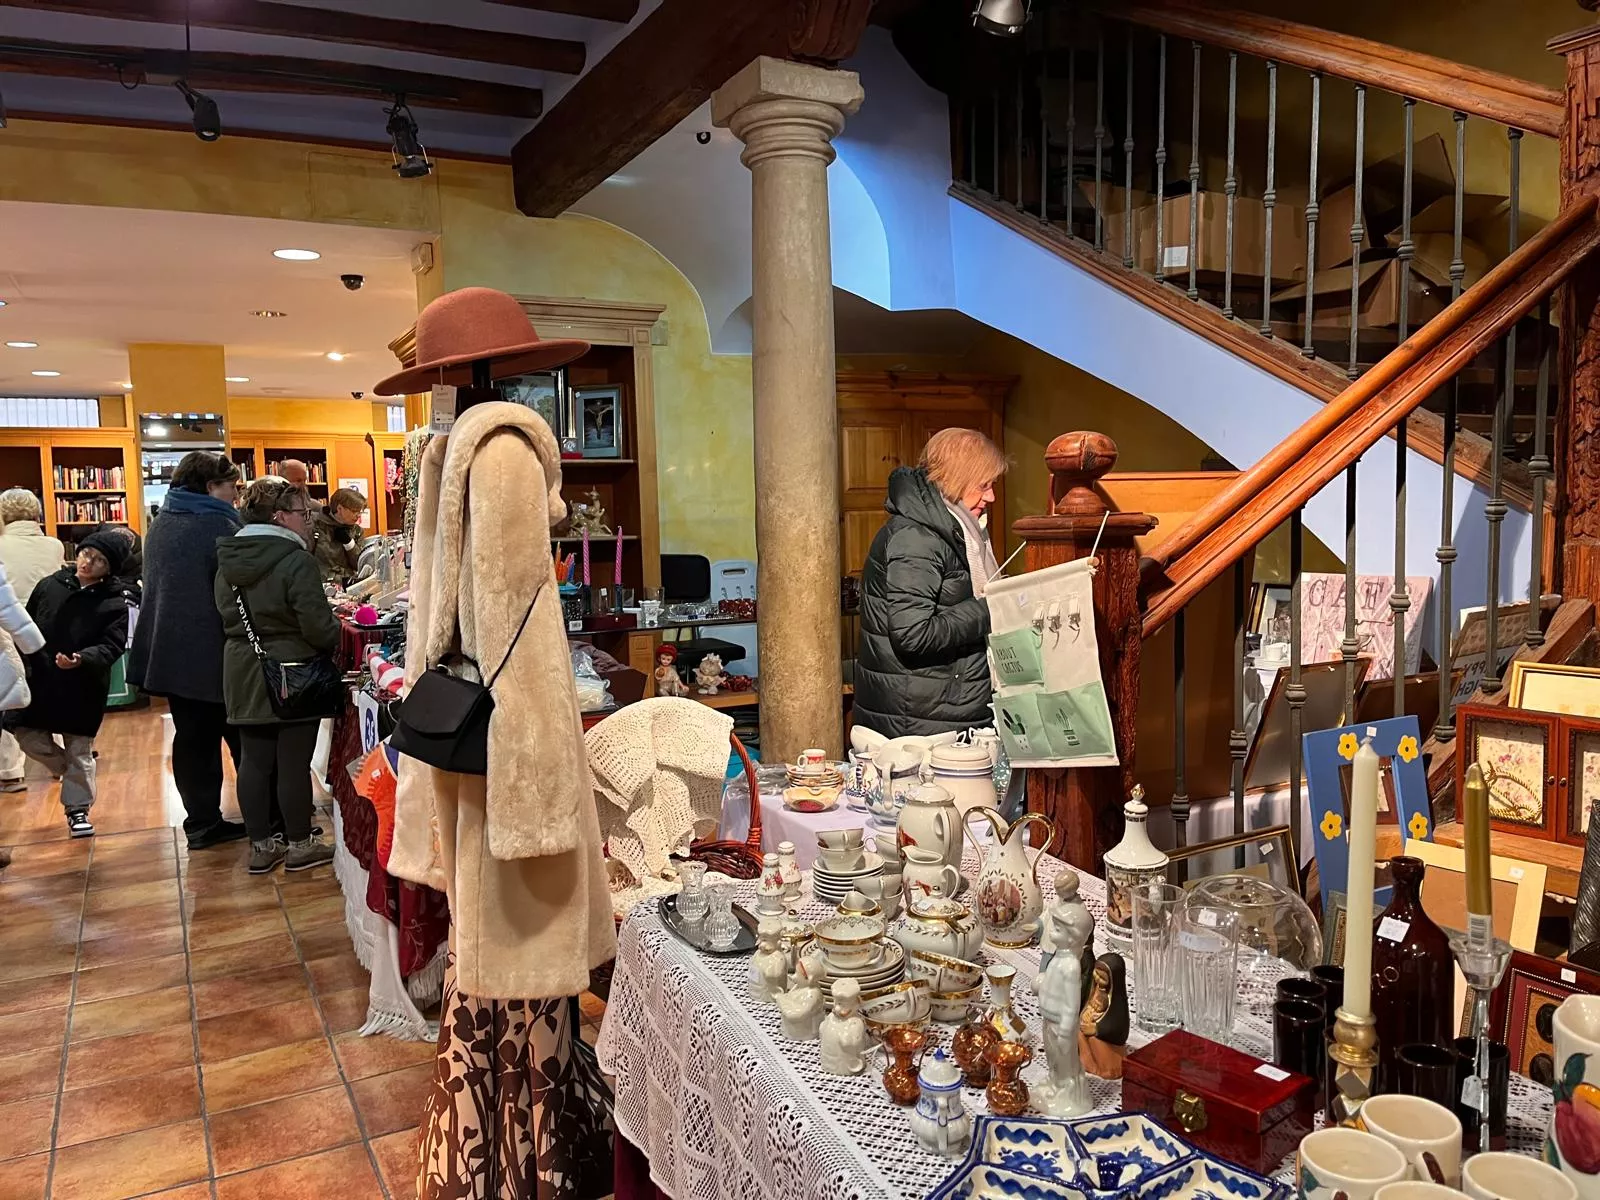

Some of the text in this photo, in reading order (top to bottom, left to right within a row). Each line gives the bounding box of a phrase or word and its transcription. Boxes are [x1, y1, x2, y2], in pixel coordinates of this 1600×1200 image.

[1308, 578, 1412, 610] CAF
[996, 646, 1017, 661] ABOUT
[1002, 660, 1024, 674] CACTUS
